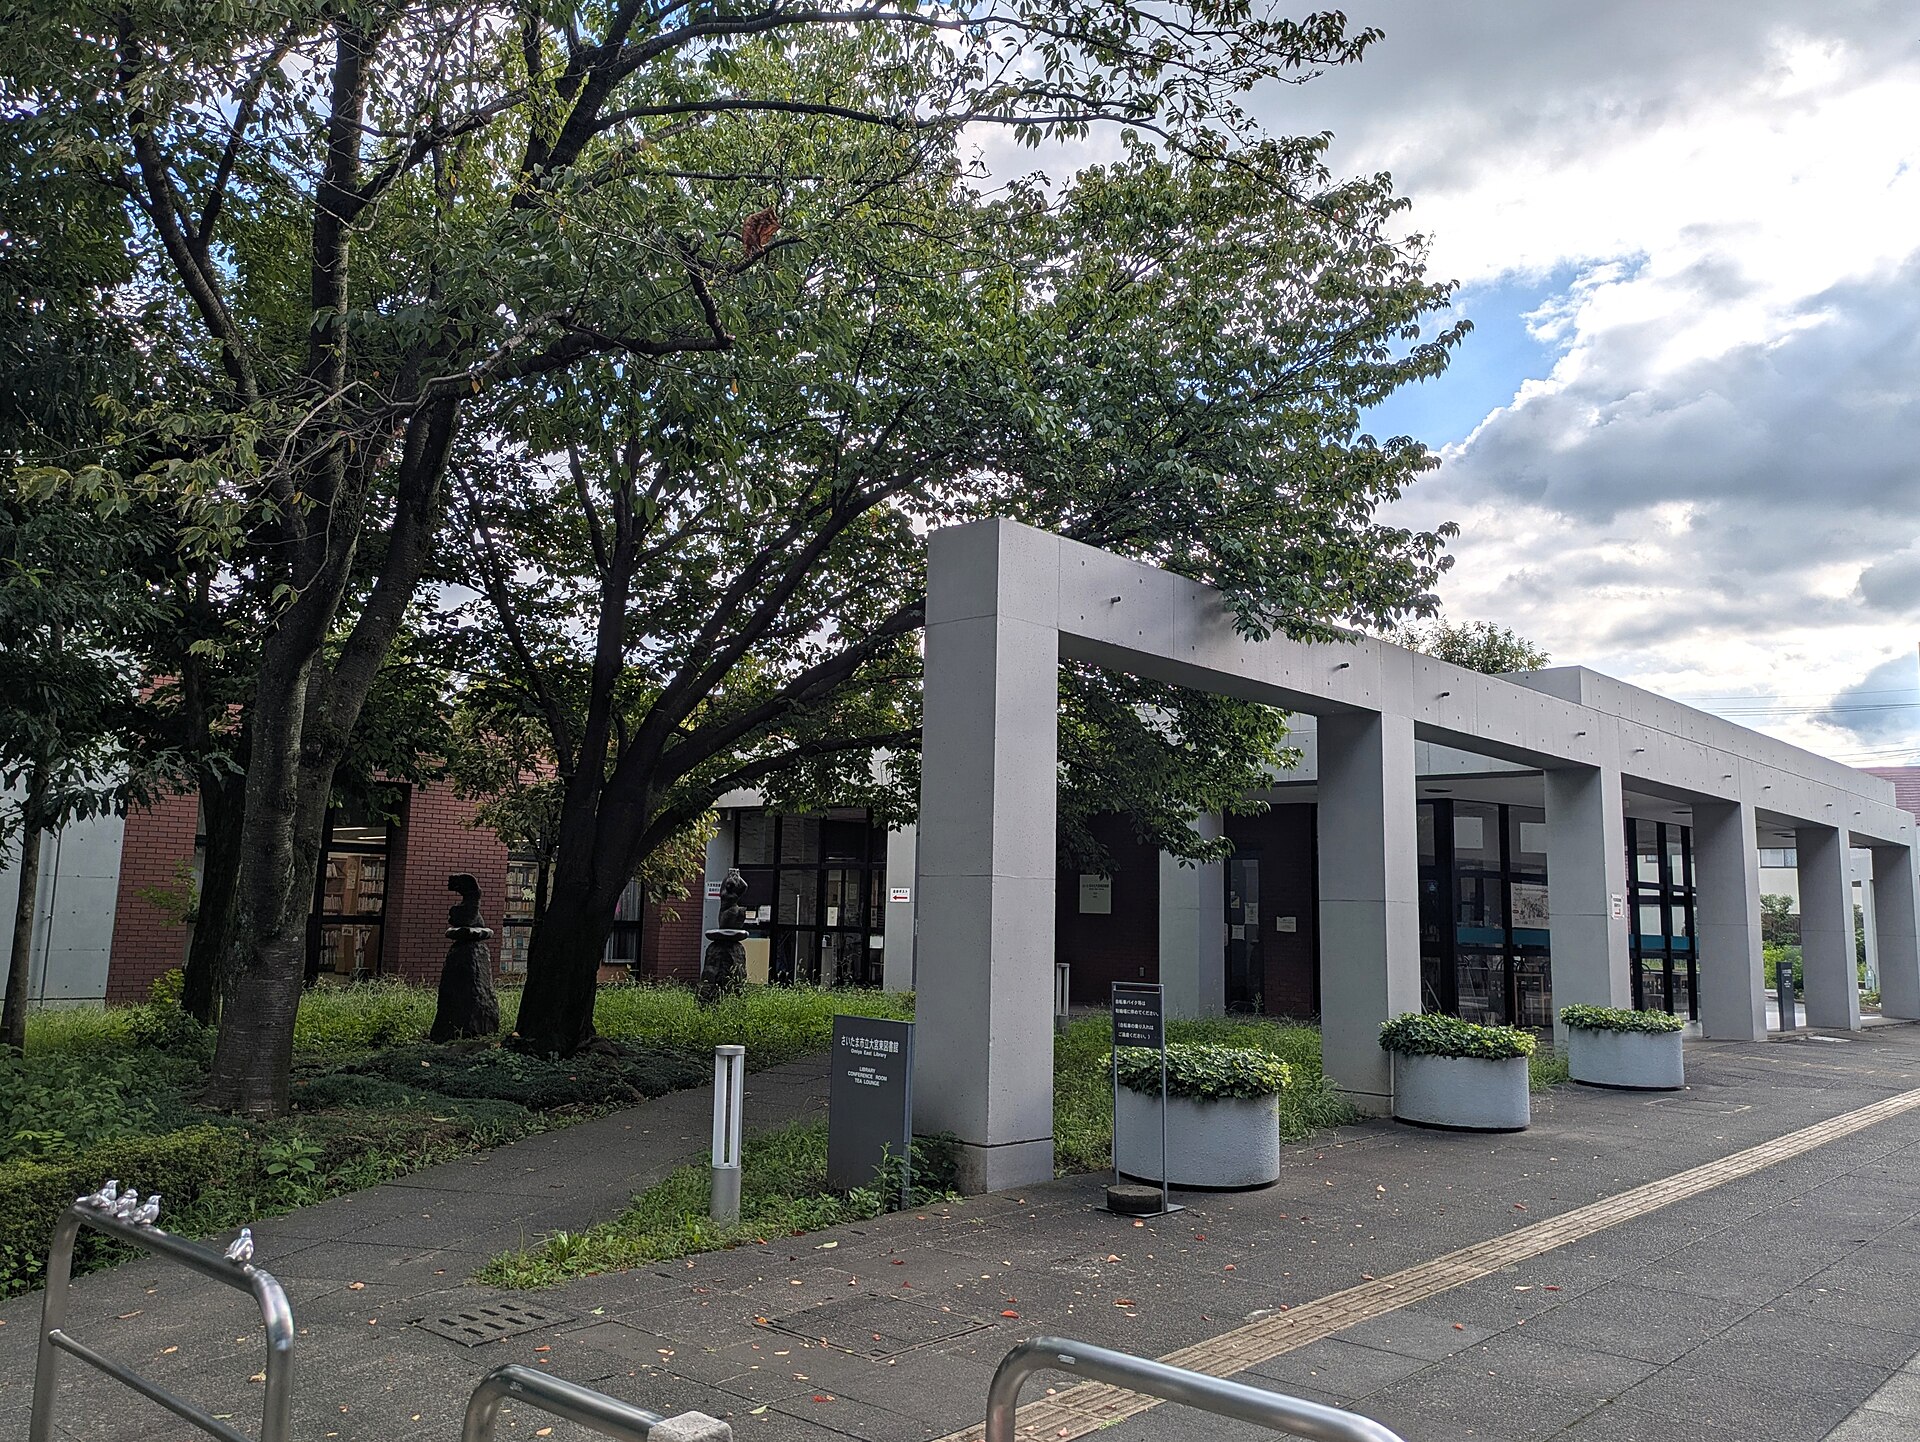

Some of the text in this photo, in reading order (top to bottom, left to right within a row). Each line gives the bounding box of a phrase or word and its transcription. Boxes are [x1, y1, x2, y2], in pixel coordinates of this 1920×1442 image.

[841, 1035, 899, 1053] さいたま市立大宮東図書館
[848, 1071, 873, 1079] CONFERENCE
